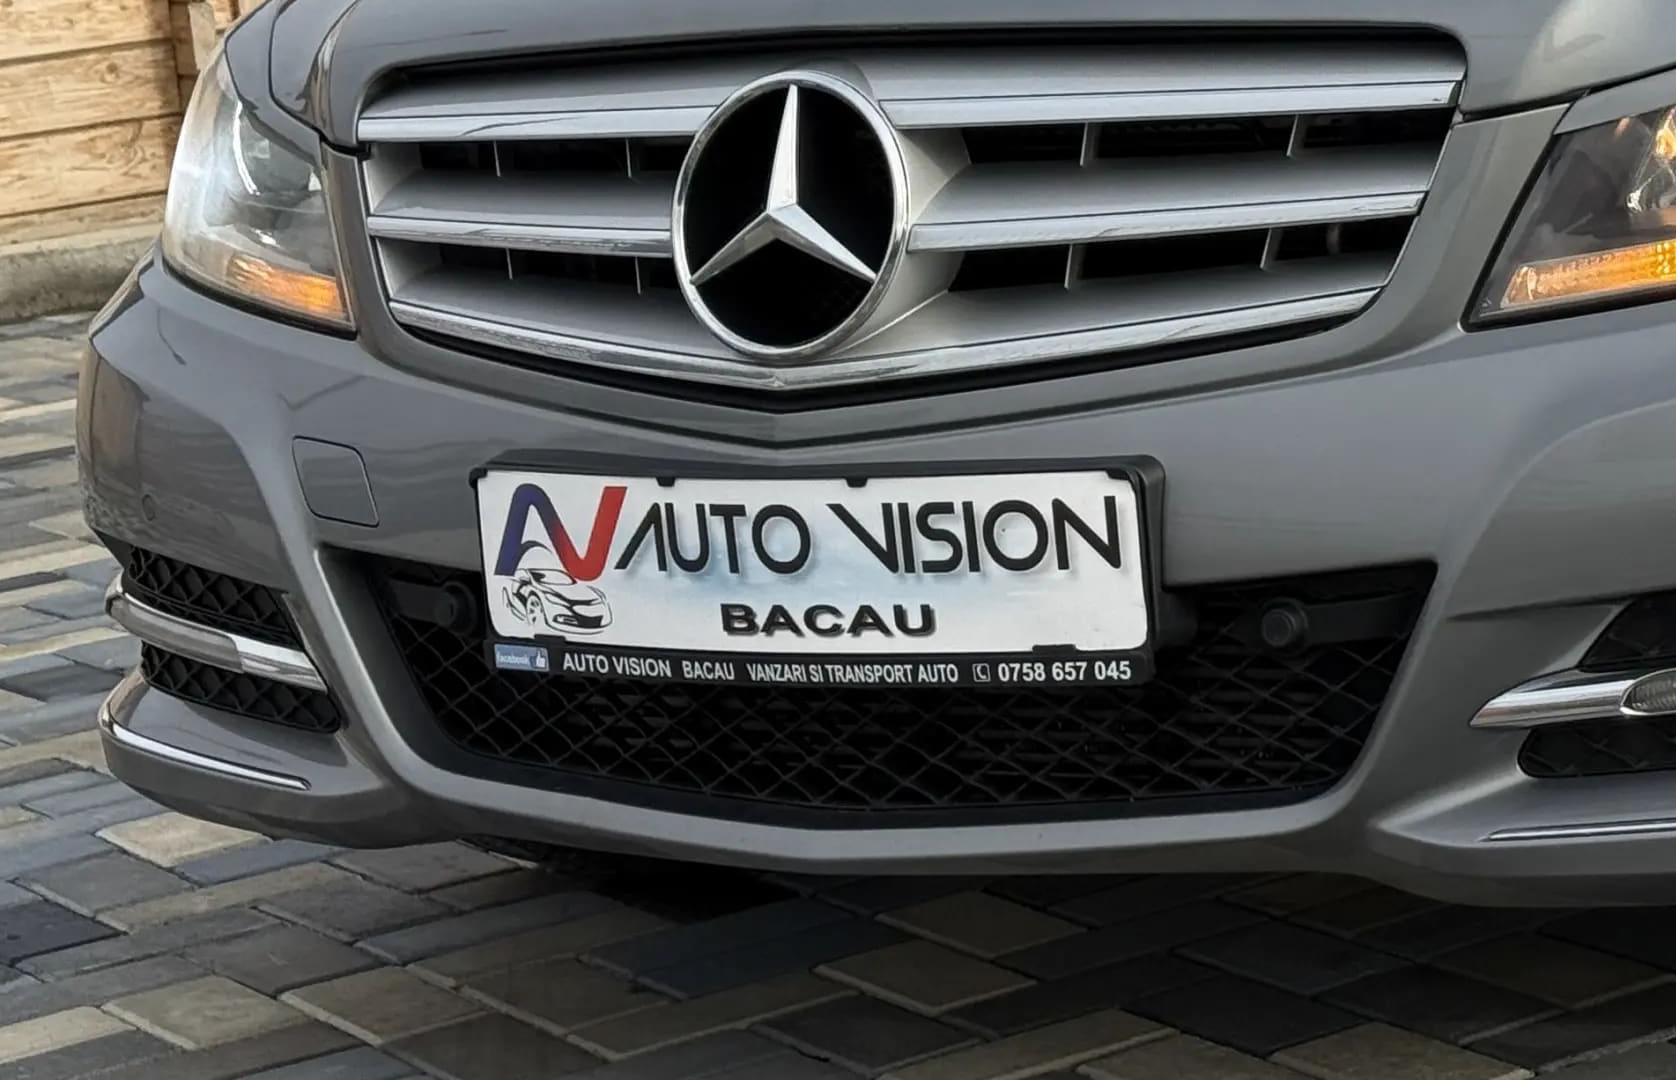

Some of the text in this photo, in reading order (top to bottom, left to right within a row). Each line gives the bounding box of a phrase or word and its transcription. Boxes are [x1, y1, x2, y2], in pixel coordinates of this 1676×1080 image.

[613, 495, 1122, 575] AUTO VISION
[720, 603, 936, 638] BACAU
[563, 653, 1131, 683] AUTO VISION BACAU VANZARI SI TRANSPORT AUTO 0758 657 045
